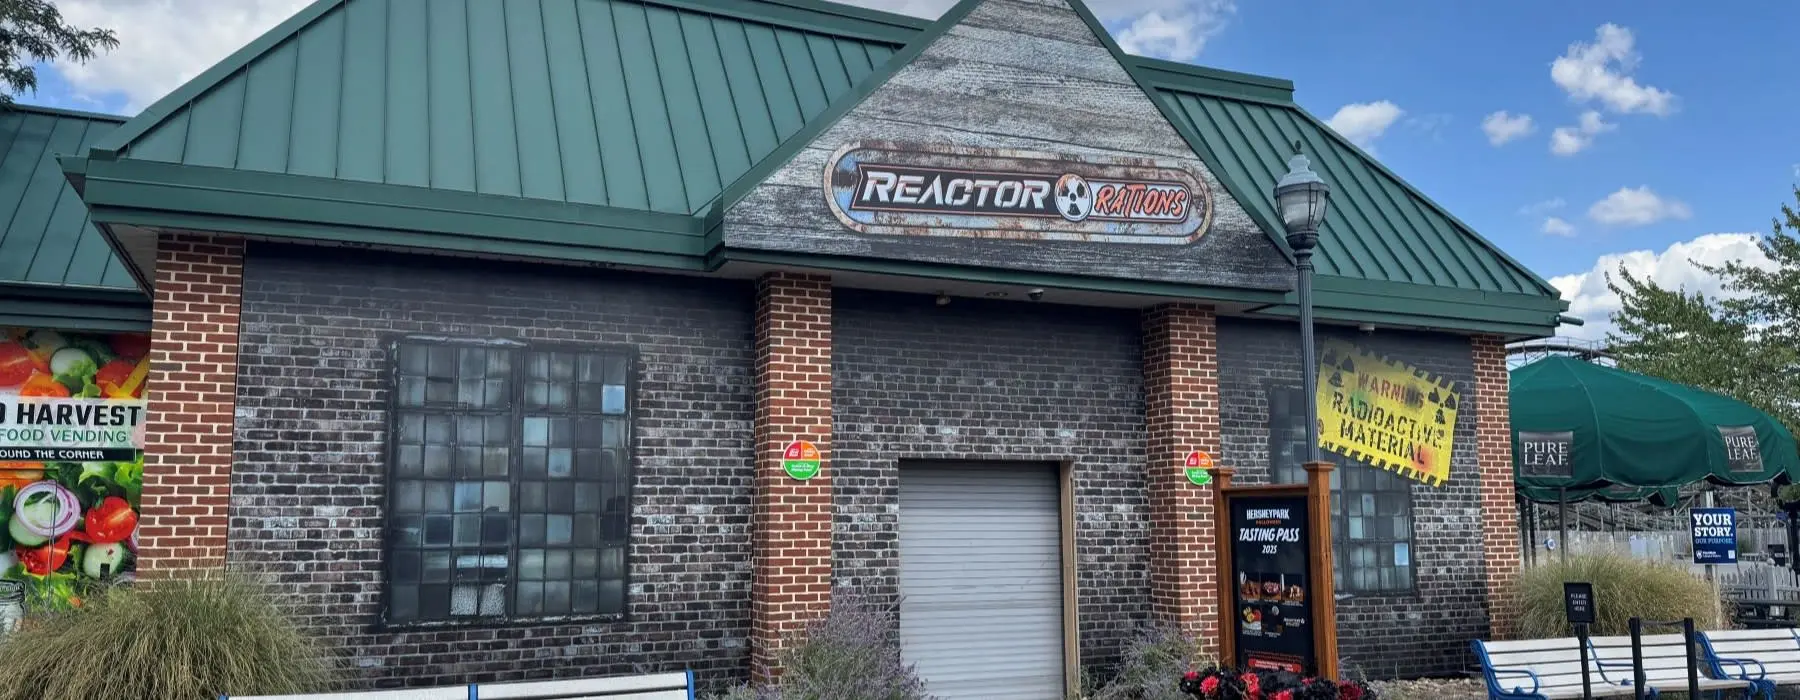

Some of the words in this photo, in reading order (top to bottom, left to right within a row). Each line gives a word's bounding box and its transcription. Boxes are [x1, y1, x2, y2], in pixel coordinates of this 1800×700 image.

[862, 170, 1051, 209] REACTOR
[1094, 181, 1188, 218] RATIONS
[1357, 370, 1425, 410] WARNING
[17, 403, 142, 426] HARVEST
[1332, 392, 1444, 448] RADIOACTIVE
[0, 429, 44, 441] FOOD
[50, 429, 127, 442] VENDING
[1339, 418, 1426, 465] MATERIAL
[1725, 436, 1756, 448] PURE
[1524, 441, 1568, 454] PURE
[34, 449, 55, 459] THE
[58, 449, 104, 460] CORNER
[1246, 508, 1290, 520] HERSHEYPARK
[1693, 514, 1732, 525] YOUR
[1239, 528, 1276, 542] TASTING
[1275, 528, 1300, 542] PASS
[1694, 527, 1733, 537] STORY.
[1261, 544, 1278, 554] 2025
